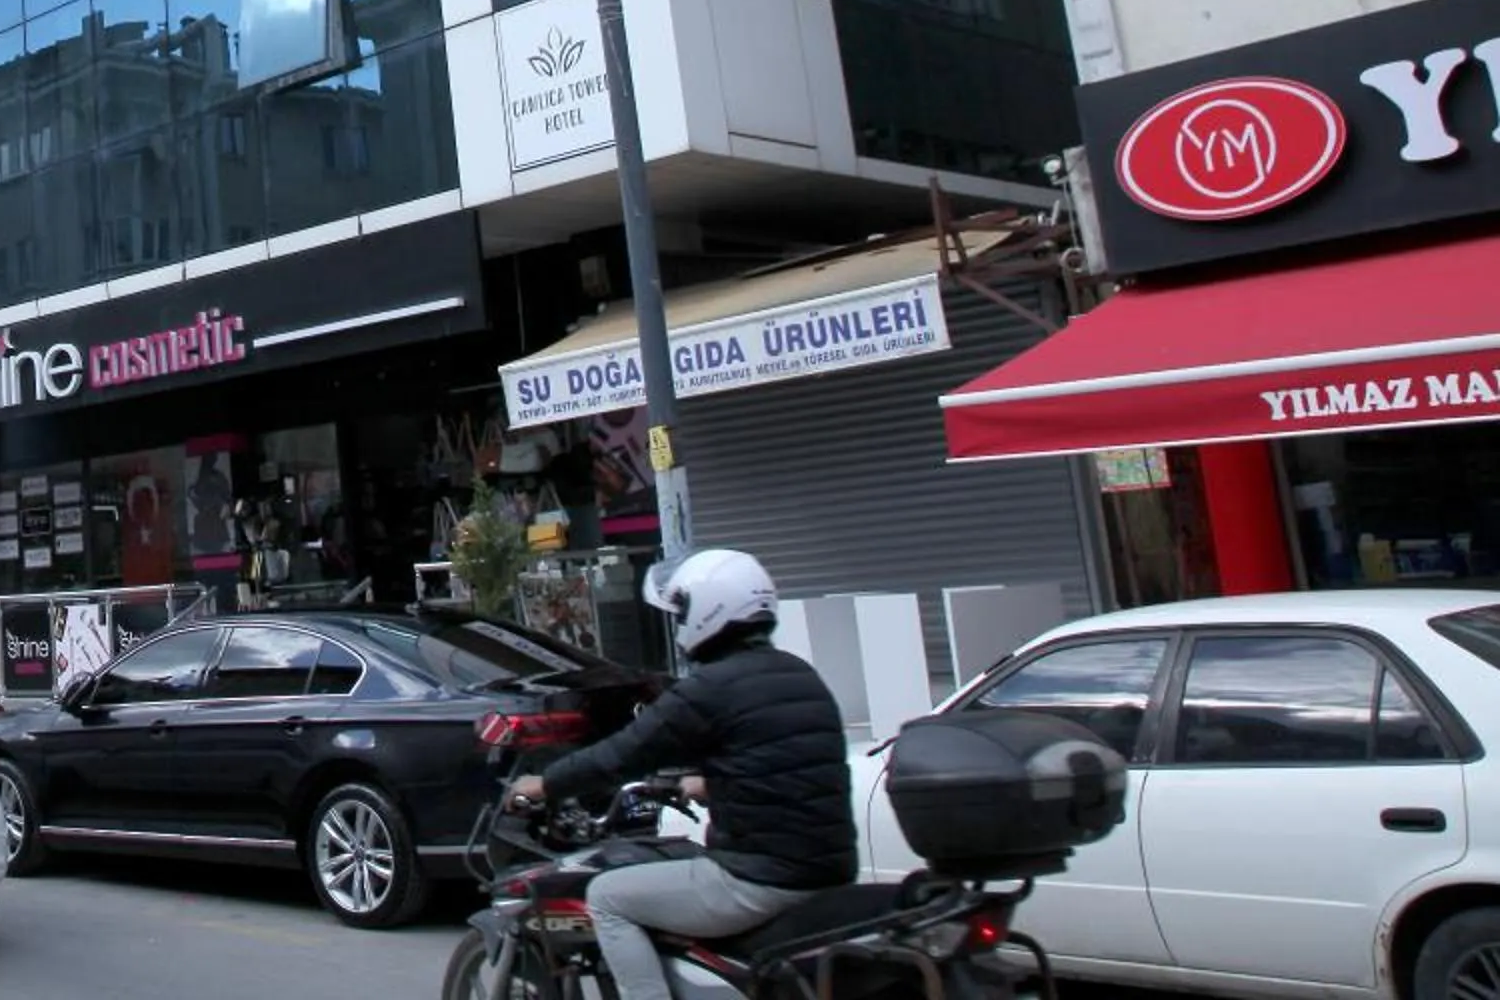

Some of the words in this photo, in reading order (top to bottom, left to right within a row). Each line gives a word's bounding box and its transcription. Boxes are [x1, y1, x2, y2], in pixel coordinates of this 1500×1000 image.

[545, 108, 584, 135] HOTEL
[88, 308, 246, 389] cosmetic
[518, 375, 551, 405] SU
[567, 353, 642, 395] DOĞA
[674, 336, 746, 375] GIDA
[763, 290, 928, 357] ÜRÜNLERİ
[1261, 378, 1418, 421] YILMAZ
[1425, 370, 1500, 407] MA
